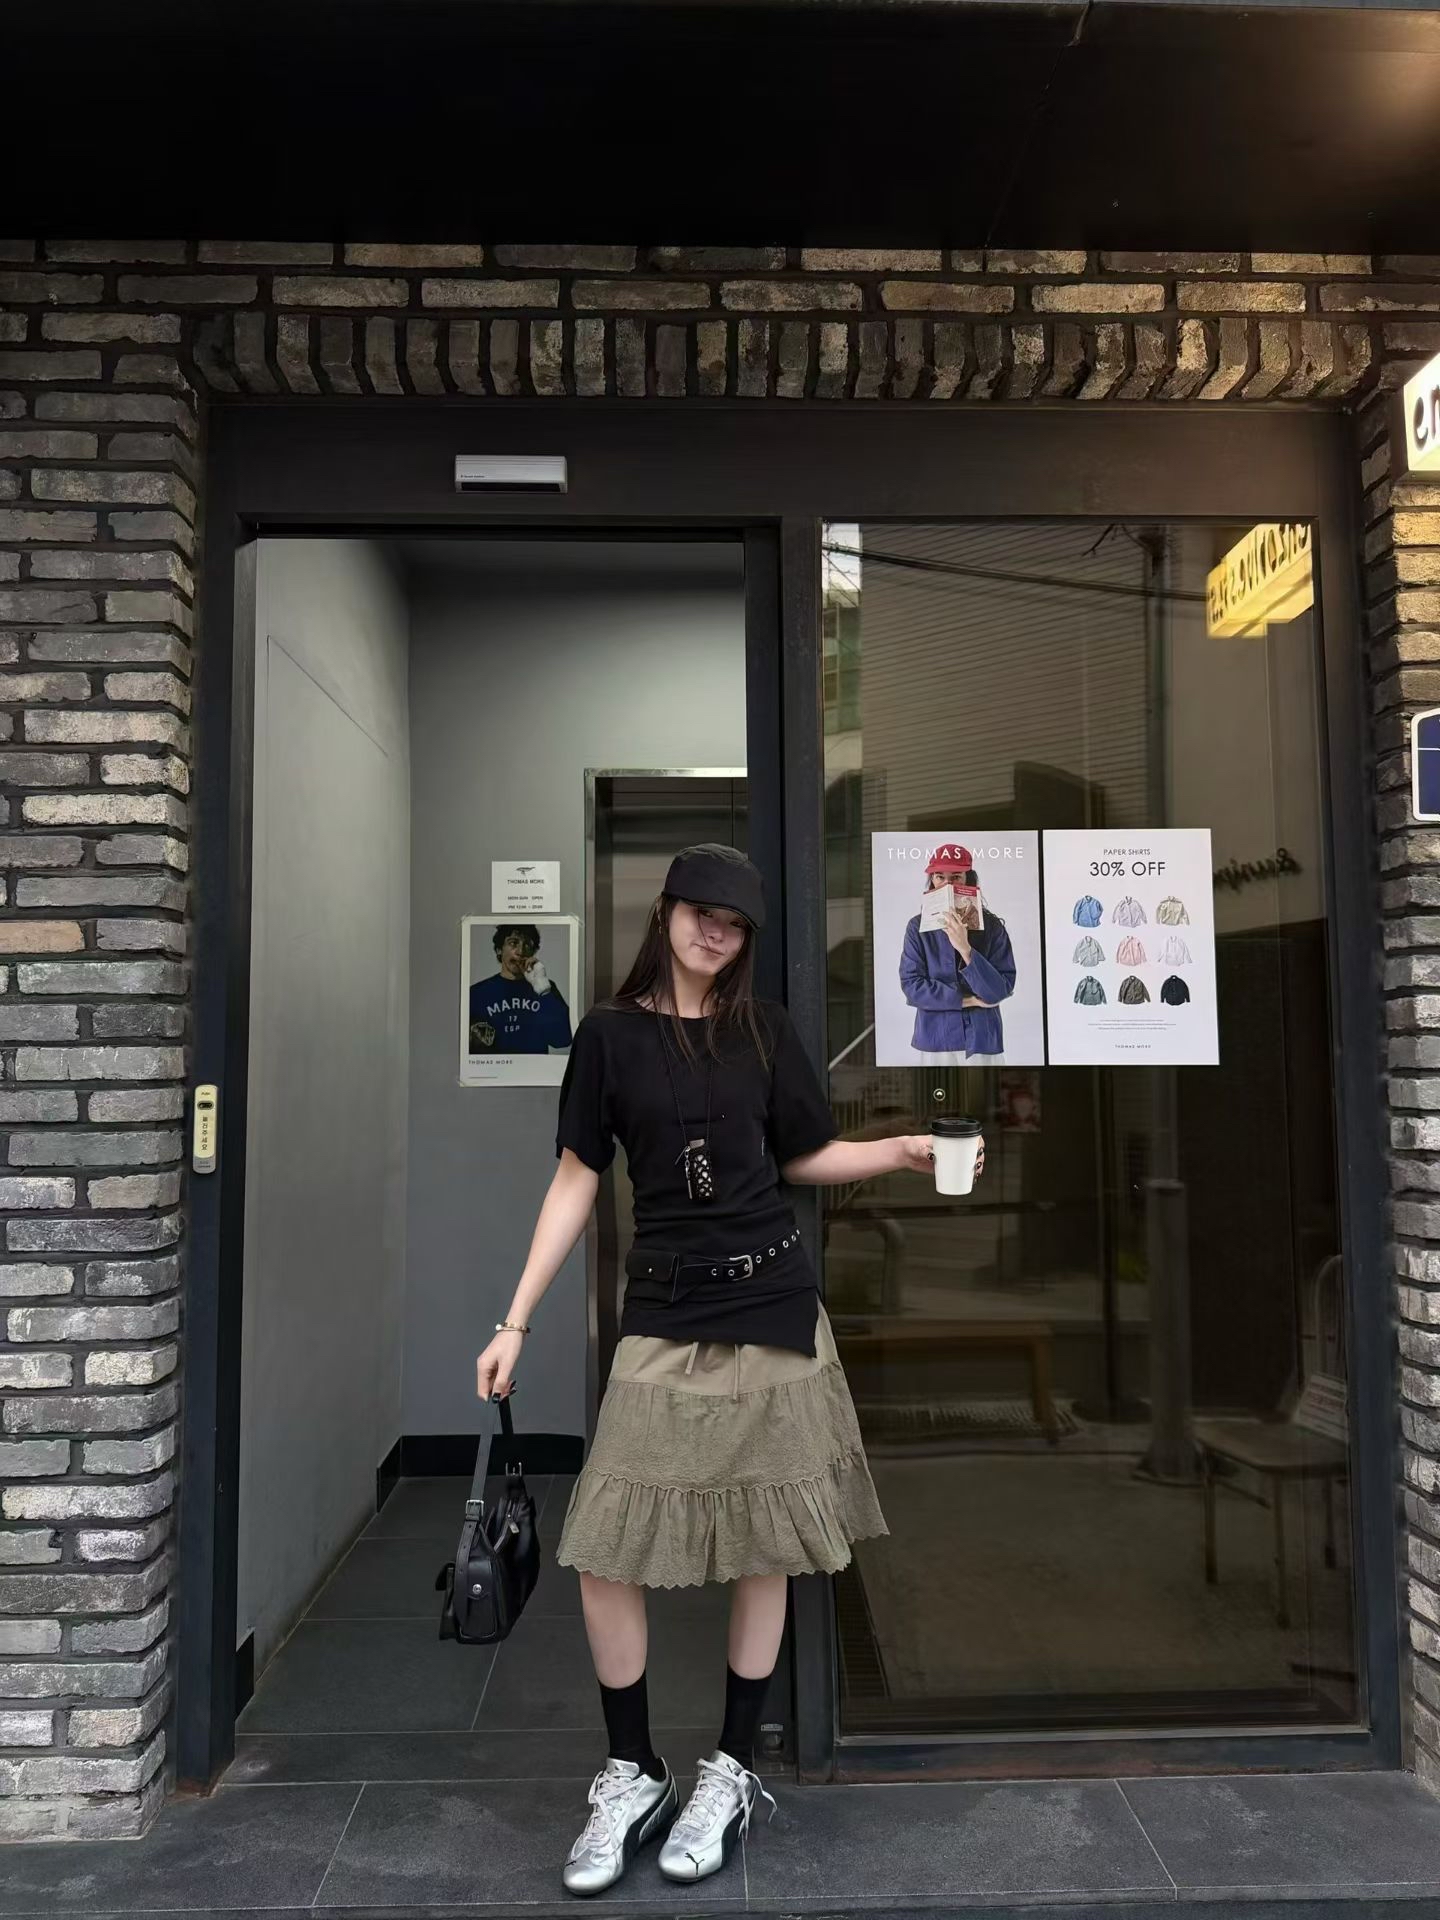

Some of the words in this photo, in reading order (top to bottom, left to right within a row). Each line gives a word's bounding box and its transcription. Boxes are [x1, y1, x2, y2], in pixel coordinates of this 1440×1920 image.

[887, 847, 962, 860] THOMAS
[971, 846, 1025, 859] MORE
[1103, 848, 1127, 856] PAPER
[1128, 848, 1151, 856] SHIRTS
[1090, 861, 1125, 877] 30%
[1131, 861, 1166, 876] OFF
[486, 997, 541, 1017] MARKO
